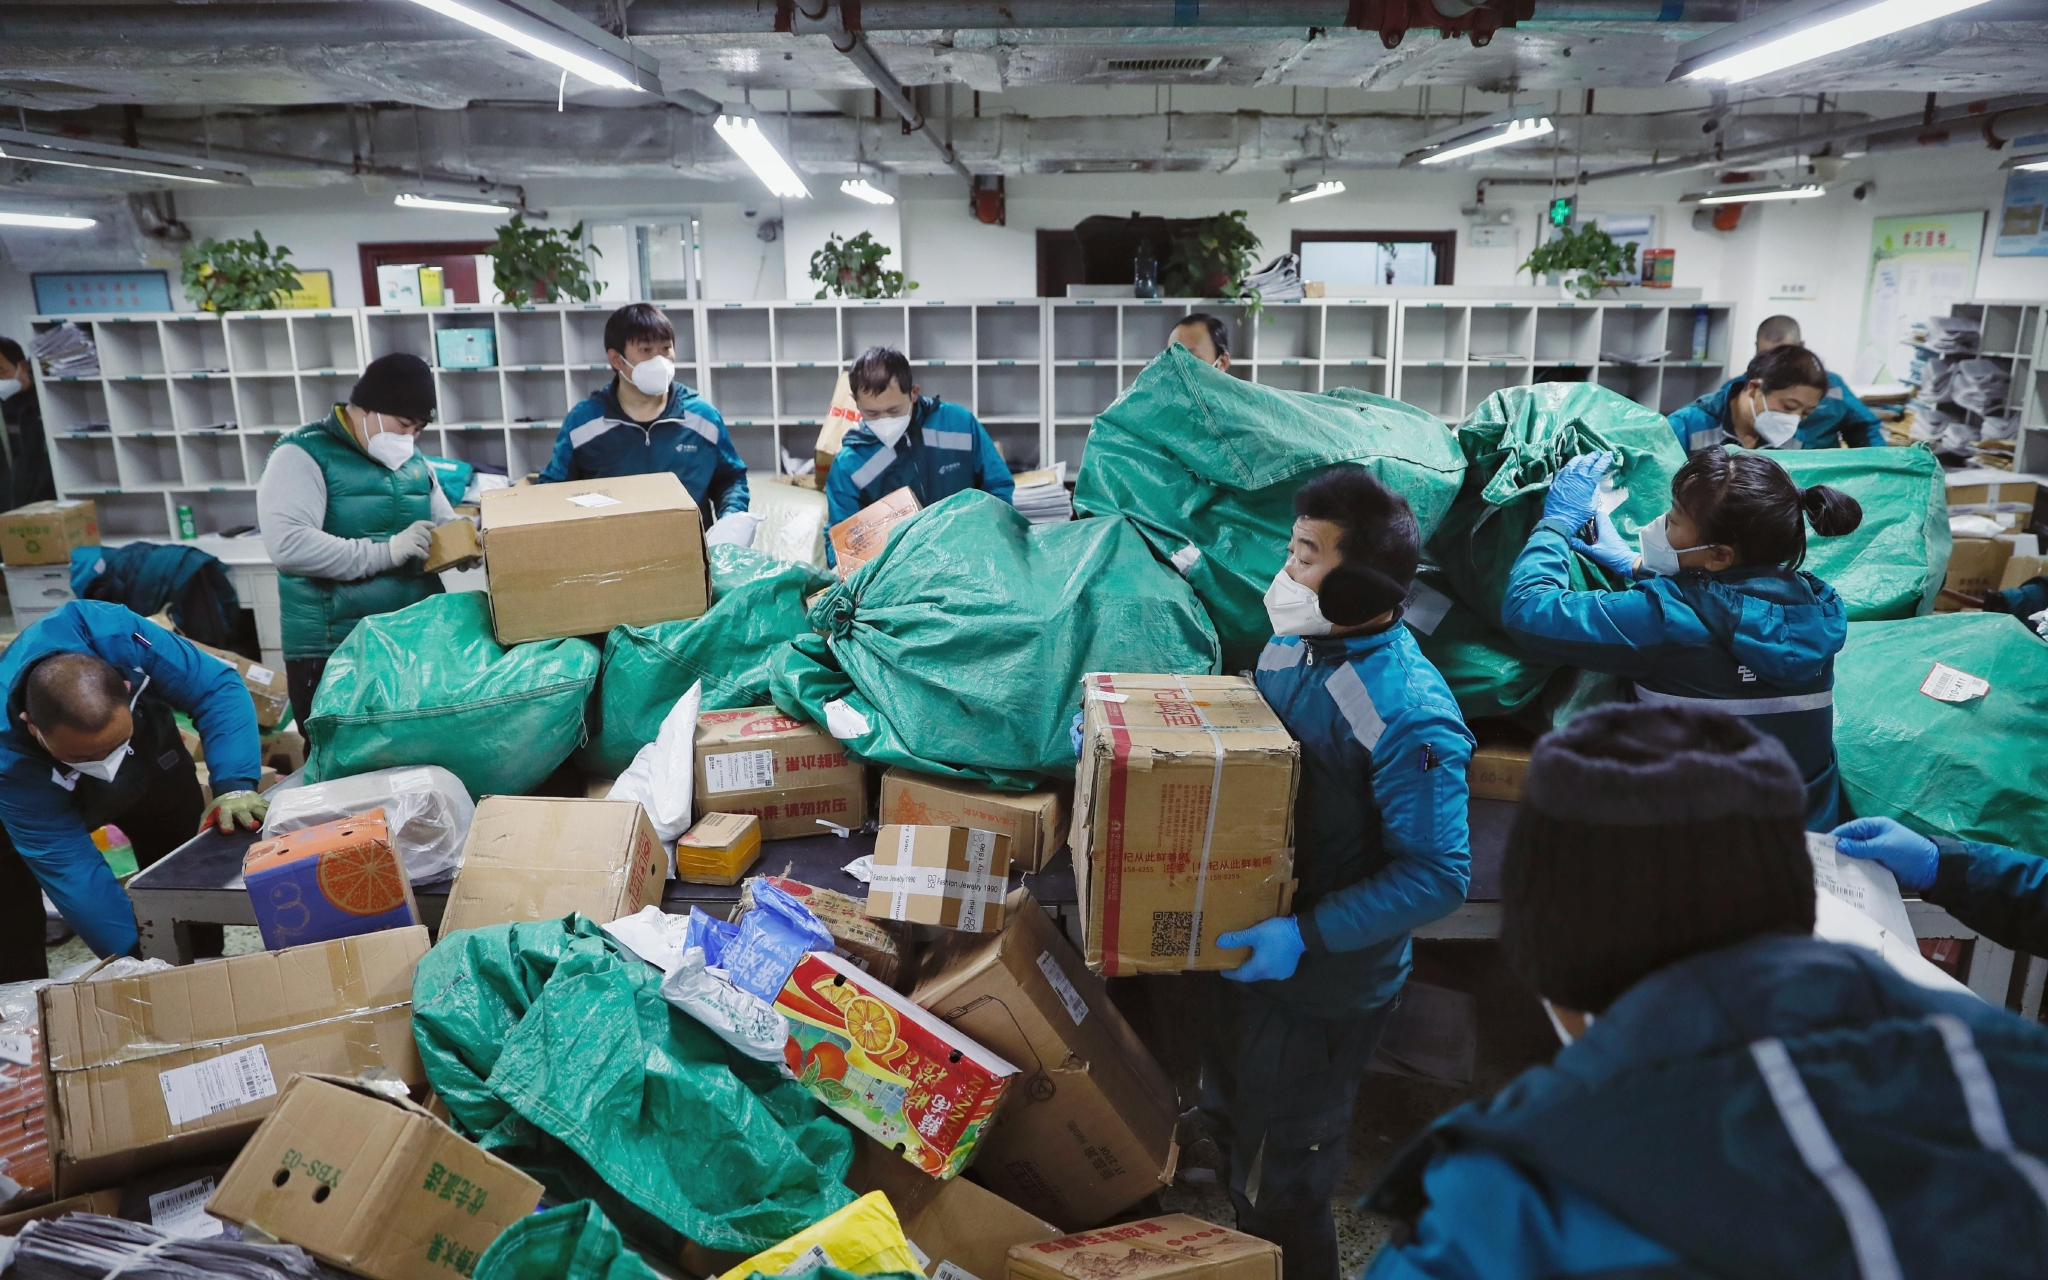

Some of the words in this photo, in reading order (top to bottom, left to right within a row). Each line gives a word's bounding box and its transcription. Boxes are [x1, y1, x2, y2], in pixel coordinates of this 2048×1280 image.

[937, 877, 958, 888] Fashion
[983, 885, 999, 894] 1990
[937, 1074, 985, 1146] GANNAN
[281, 1148, 343, 1188] YBS-03
[1098, 1145, 1126, 1176] JT-270F
[422, 1160, 489, 1217] 优先派送
